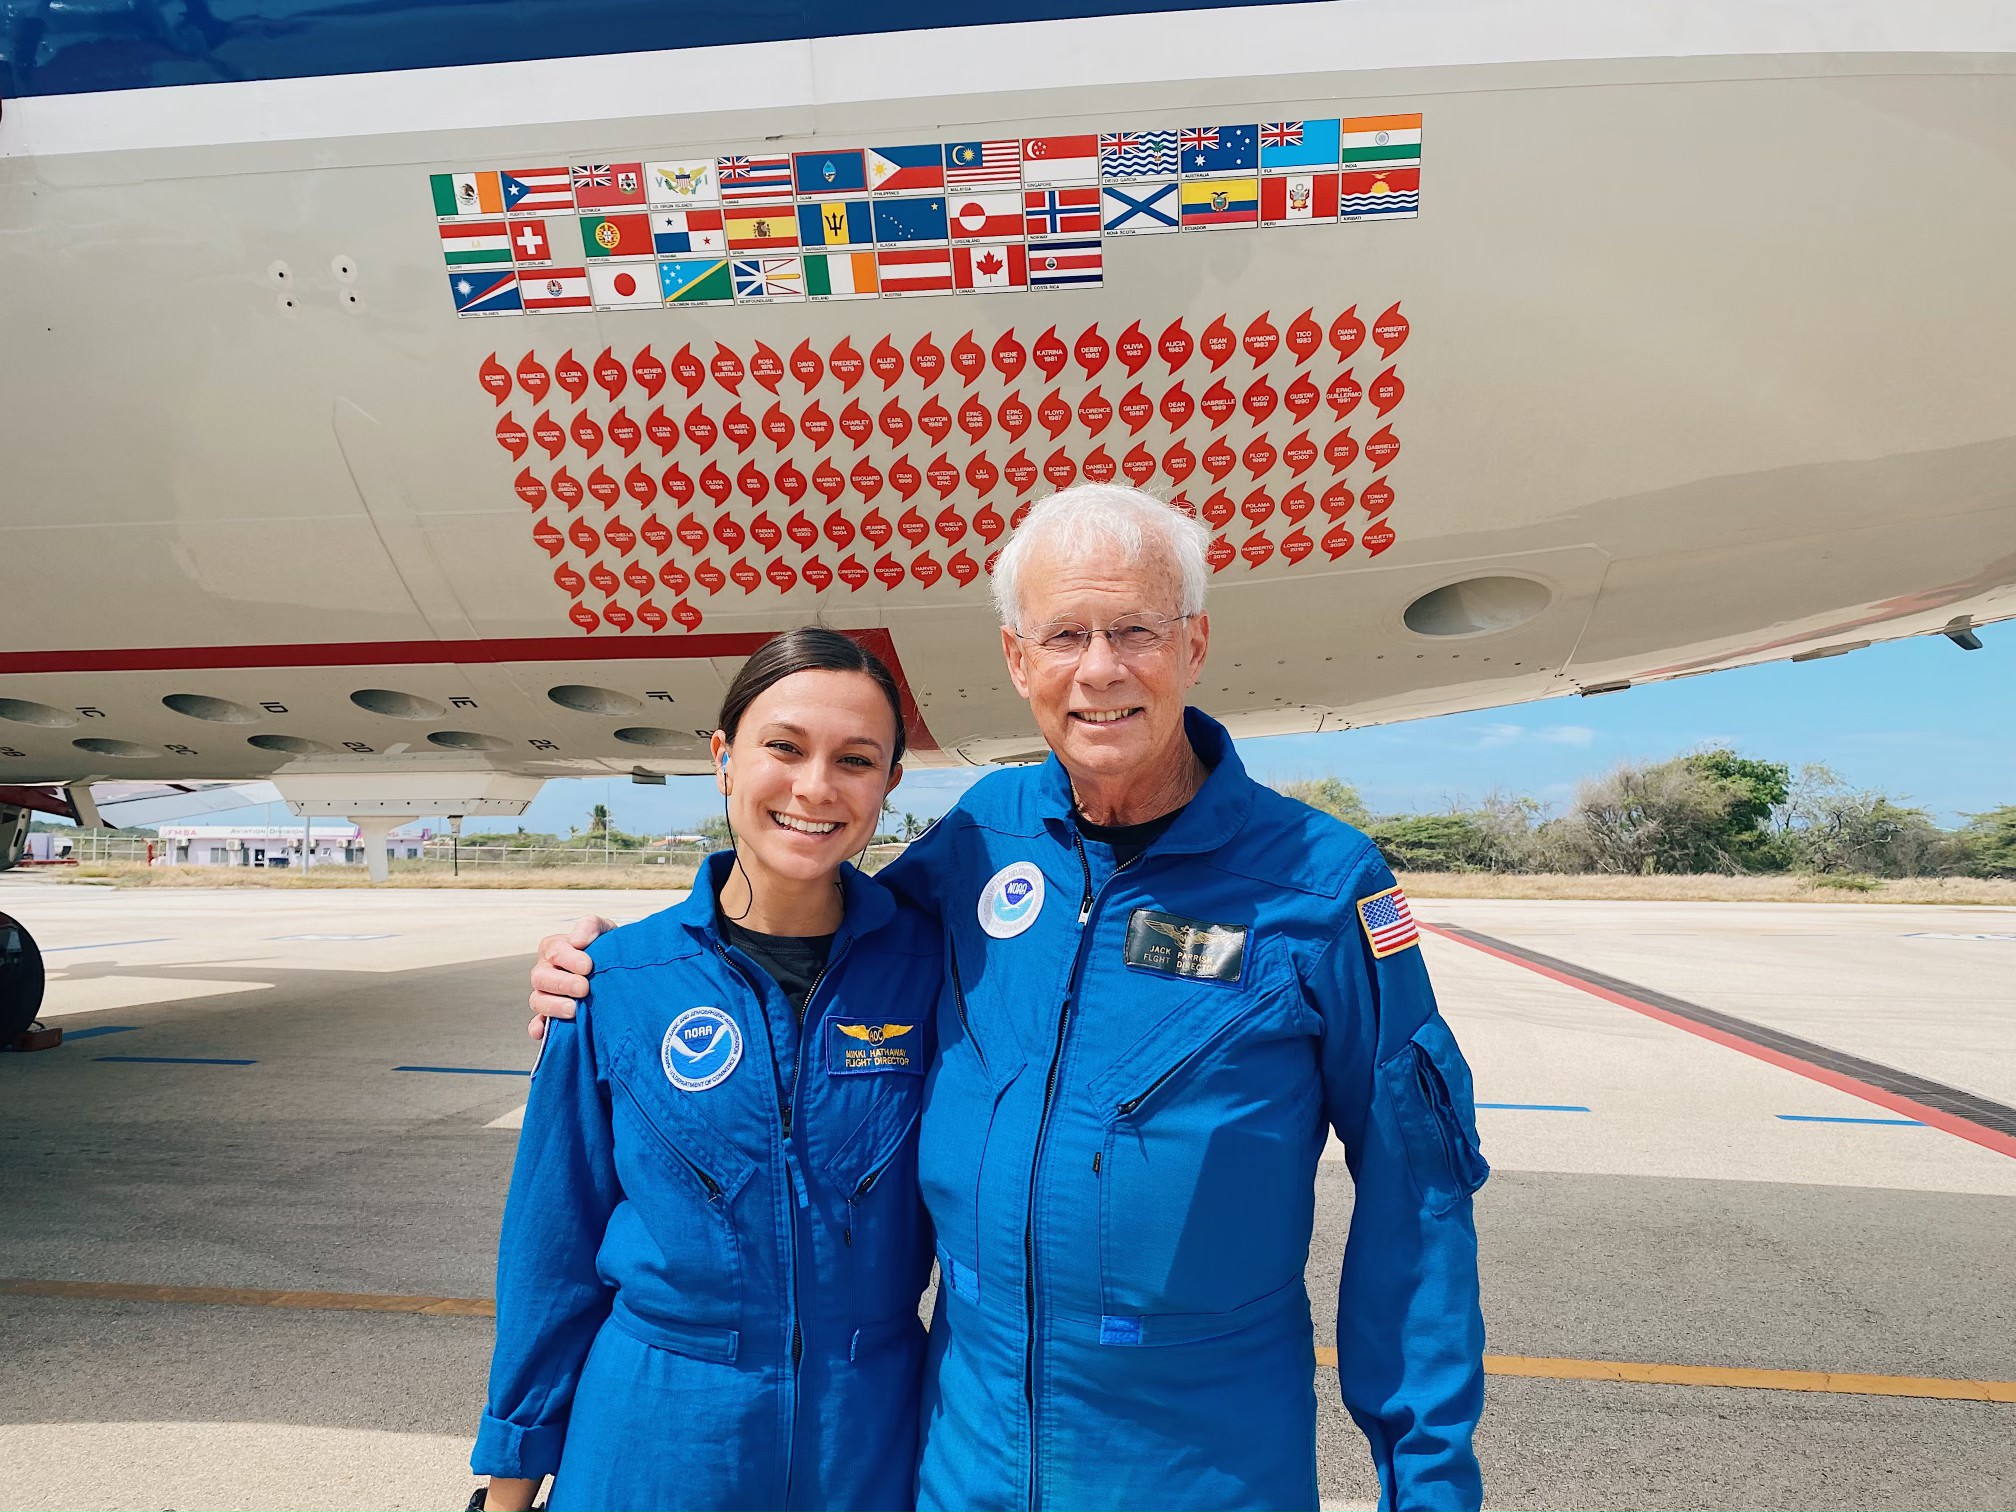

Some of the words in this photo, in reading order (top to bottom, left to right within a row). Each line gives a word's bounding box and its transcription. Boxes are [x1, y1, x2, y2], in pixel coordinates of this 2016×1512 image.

[1296, 330, 1312, 338] TICO
[1337, 328, 1357, 336] DIANA
[1375, 325, 1406, 334] NORBERT
[1209, 337, 1227, 345] DEAN
[1245, 334, 1277, 343] RAYMOND
[1296, 336, 1312, 344] 1983
[1339, 333, 1355, 341] 1984
[1123, 343, 1143, 351] OLIVIA
[1165, 340, 1186, 348] ALICIA
[1036, 349, 1063, 357] KATRINA
[1080, 346, 1102, 354] DEBBY
[831, 359, 861, 367] FREDERIC
[1289, 392, 1314, 400] GUSTAV
[1326, 390, 1362, 400] GUILLERMO
[1201, 398, 1235, 407] GABRIELLE
[1123, 404, 1149, 412] GILBERT
[1366, 443, 1400, 451] GABRIELLE
[1364, 533, 1394, 541] PAULETTE
[645, 691, 675, 704] 1F
[259, 701, 289, 713] 1D
[448, 696, 479, 709] 1E
[75, 706, 106, 718] 1C
[341, 741, 375, 753] 2D
[527, 738, 560, 751] 2E
[163, 744, 198, 756] 2C
[1007, 882, 1028, 895] NOAA
[1149, 945, 1172, 955] JACK
[1177, 951, 1213, 964] PARRISH
[1176, 960, 1218, 972] DIRECTOR
[684, 1025, 713, 1040] NOAA
[845, 1049, 866, 1058] NIKKI
[869, 1048, 907, 1058] HATHAWAY
[845, 1058, 873, 1067] FLIGHT
[874, 1057, 910, 1066] DIRECTOR
